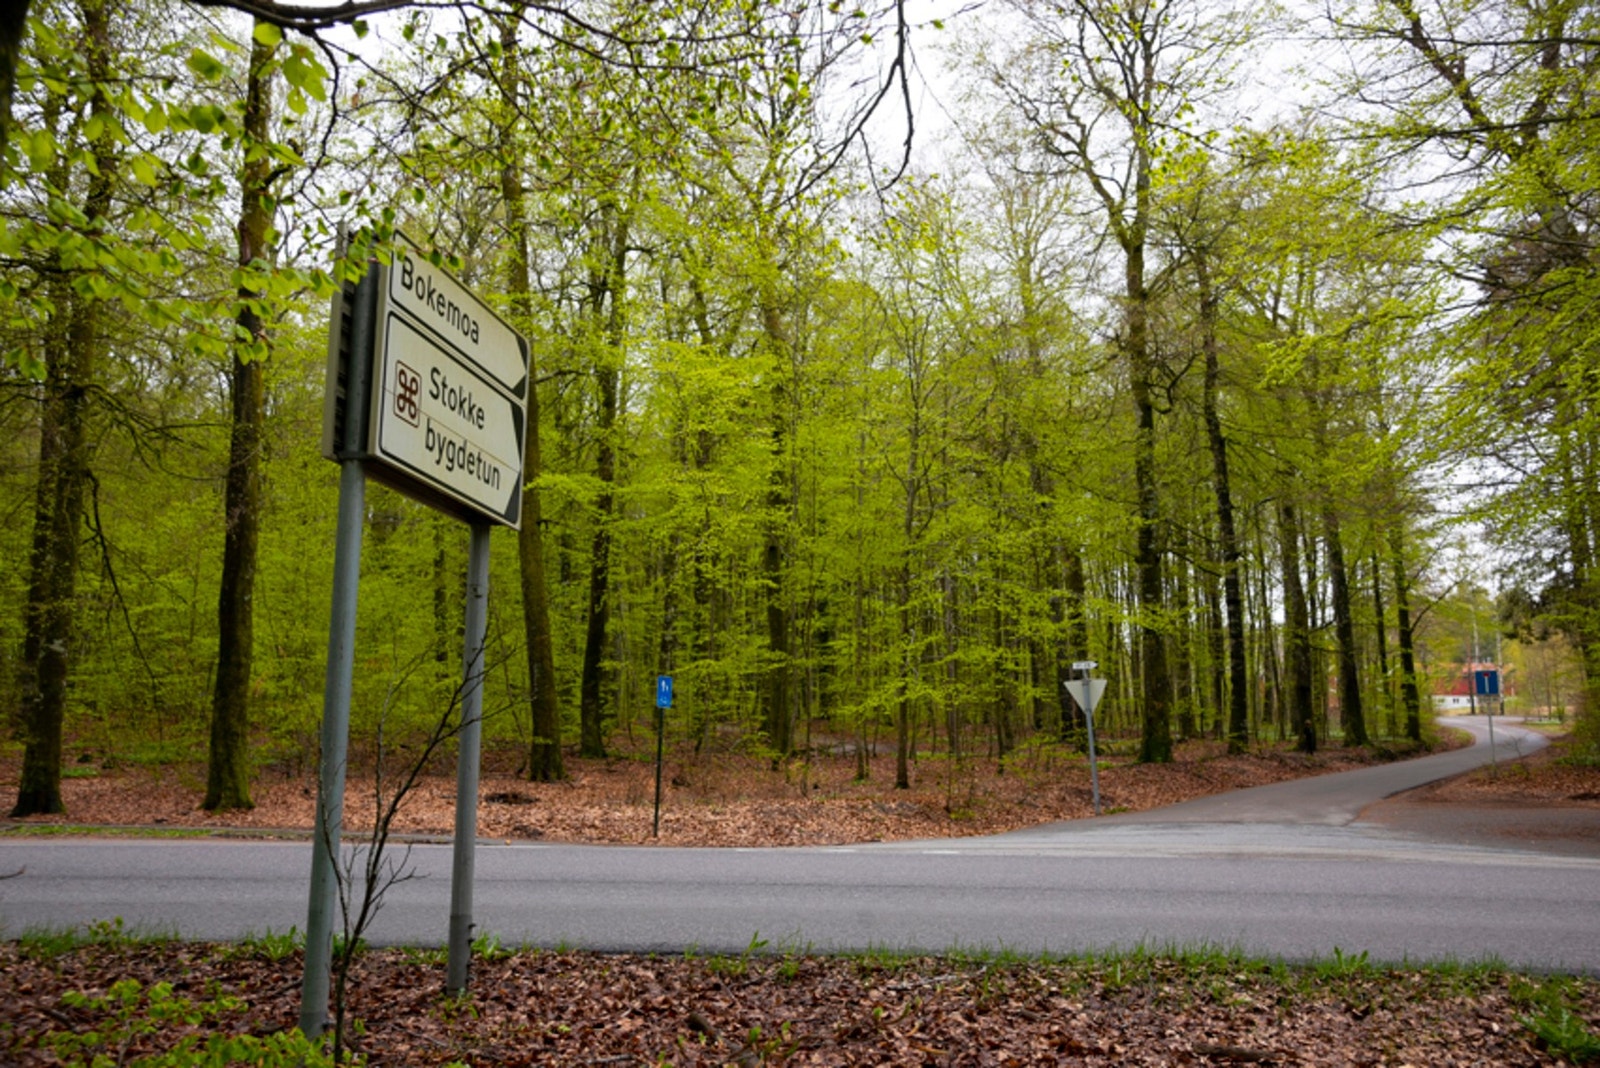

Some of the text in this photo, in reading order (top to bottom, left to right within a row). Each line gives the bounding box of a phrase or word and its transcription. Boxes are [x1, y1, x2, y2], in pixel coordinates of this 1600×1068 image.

[401, 255, 480, 345] Bokemoa
[429, 366, 485, 430] Stokke
[425, 417, 500, 491] bygdetun
